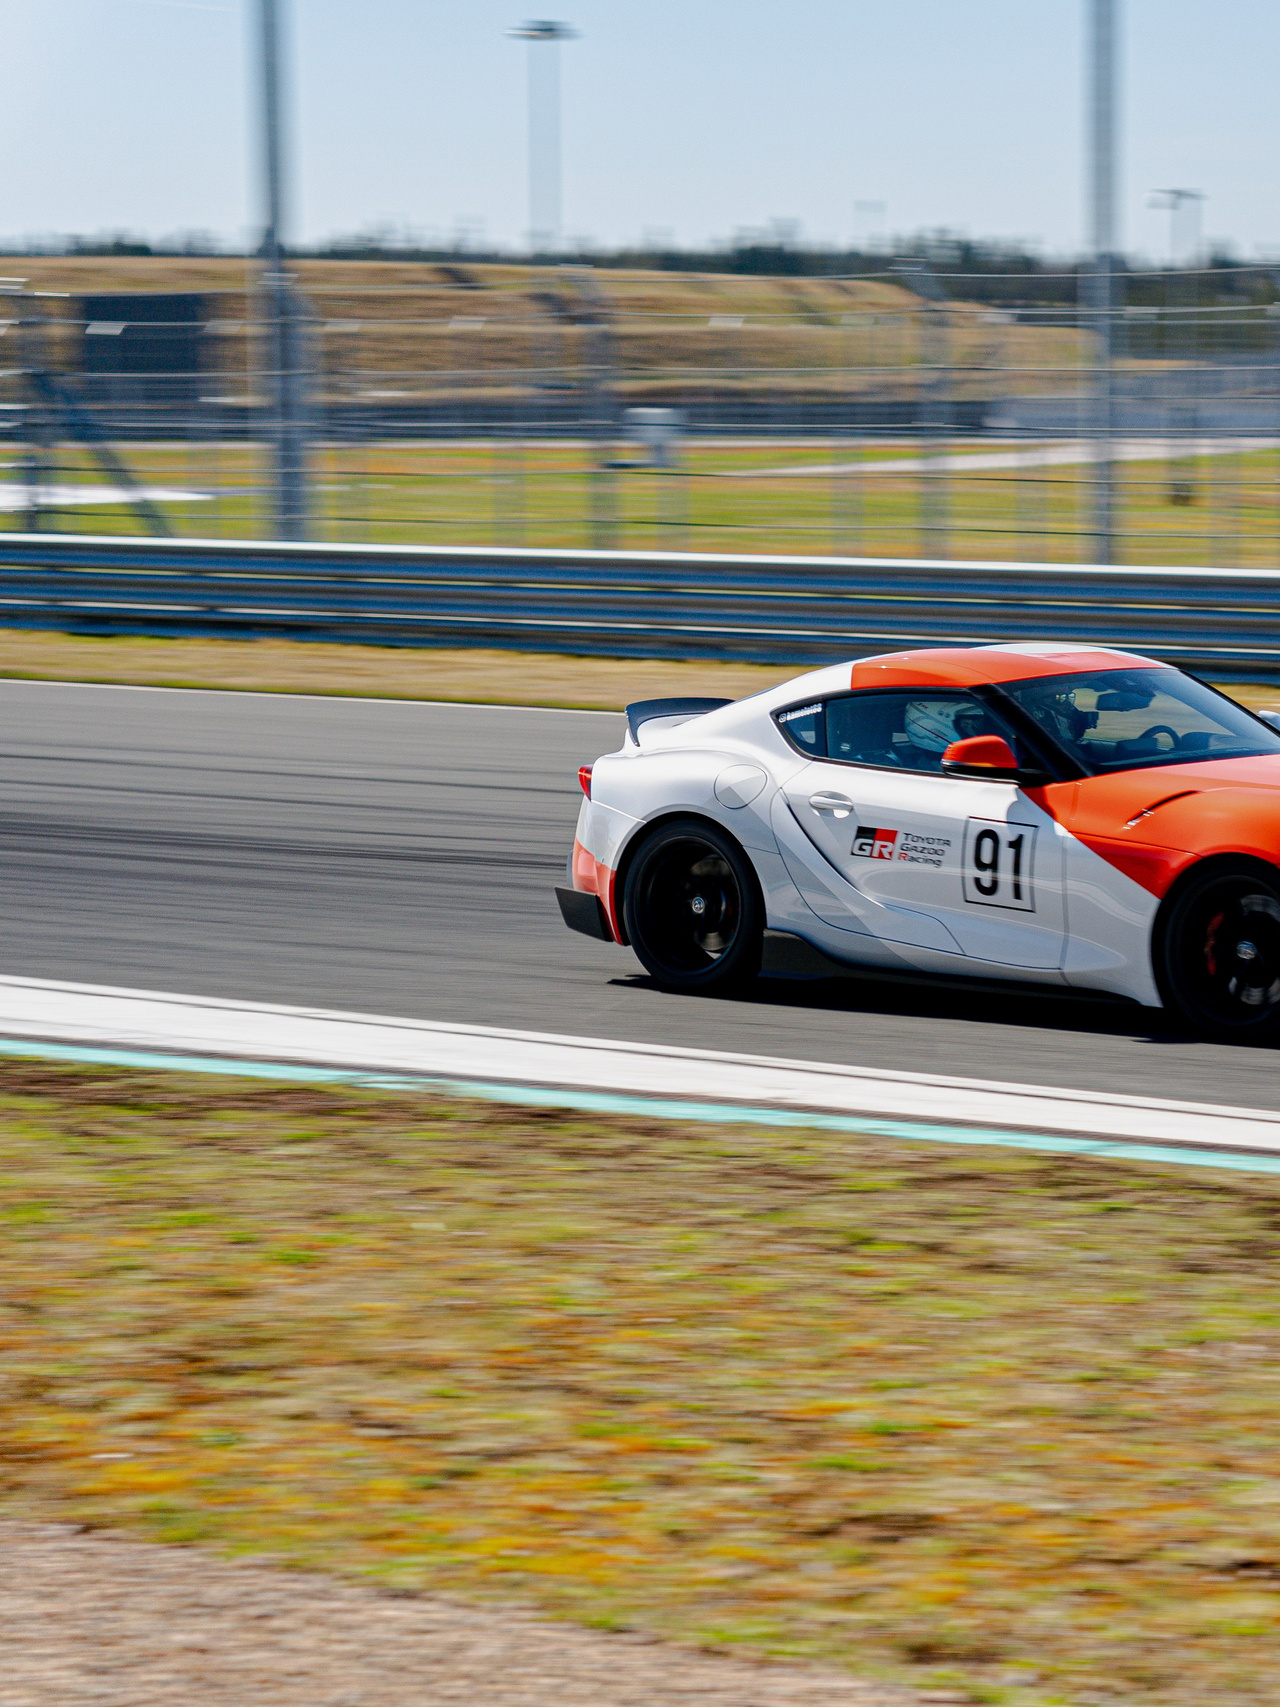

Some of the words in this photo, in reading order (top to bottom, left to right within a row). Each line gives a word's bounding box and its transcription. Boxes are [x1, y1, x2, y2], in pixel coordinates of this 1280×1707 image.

[903, 832, 951, 847] TOYOTA
[852, 838, 893, 860] GR
[900, 843, 945, 856] GAZOO
[897, 852, 942, 868] Racing
[973, 828, 1025, 900] 91
